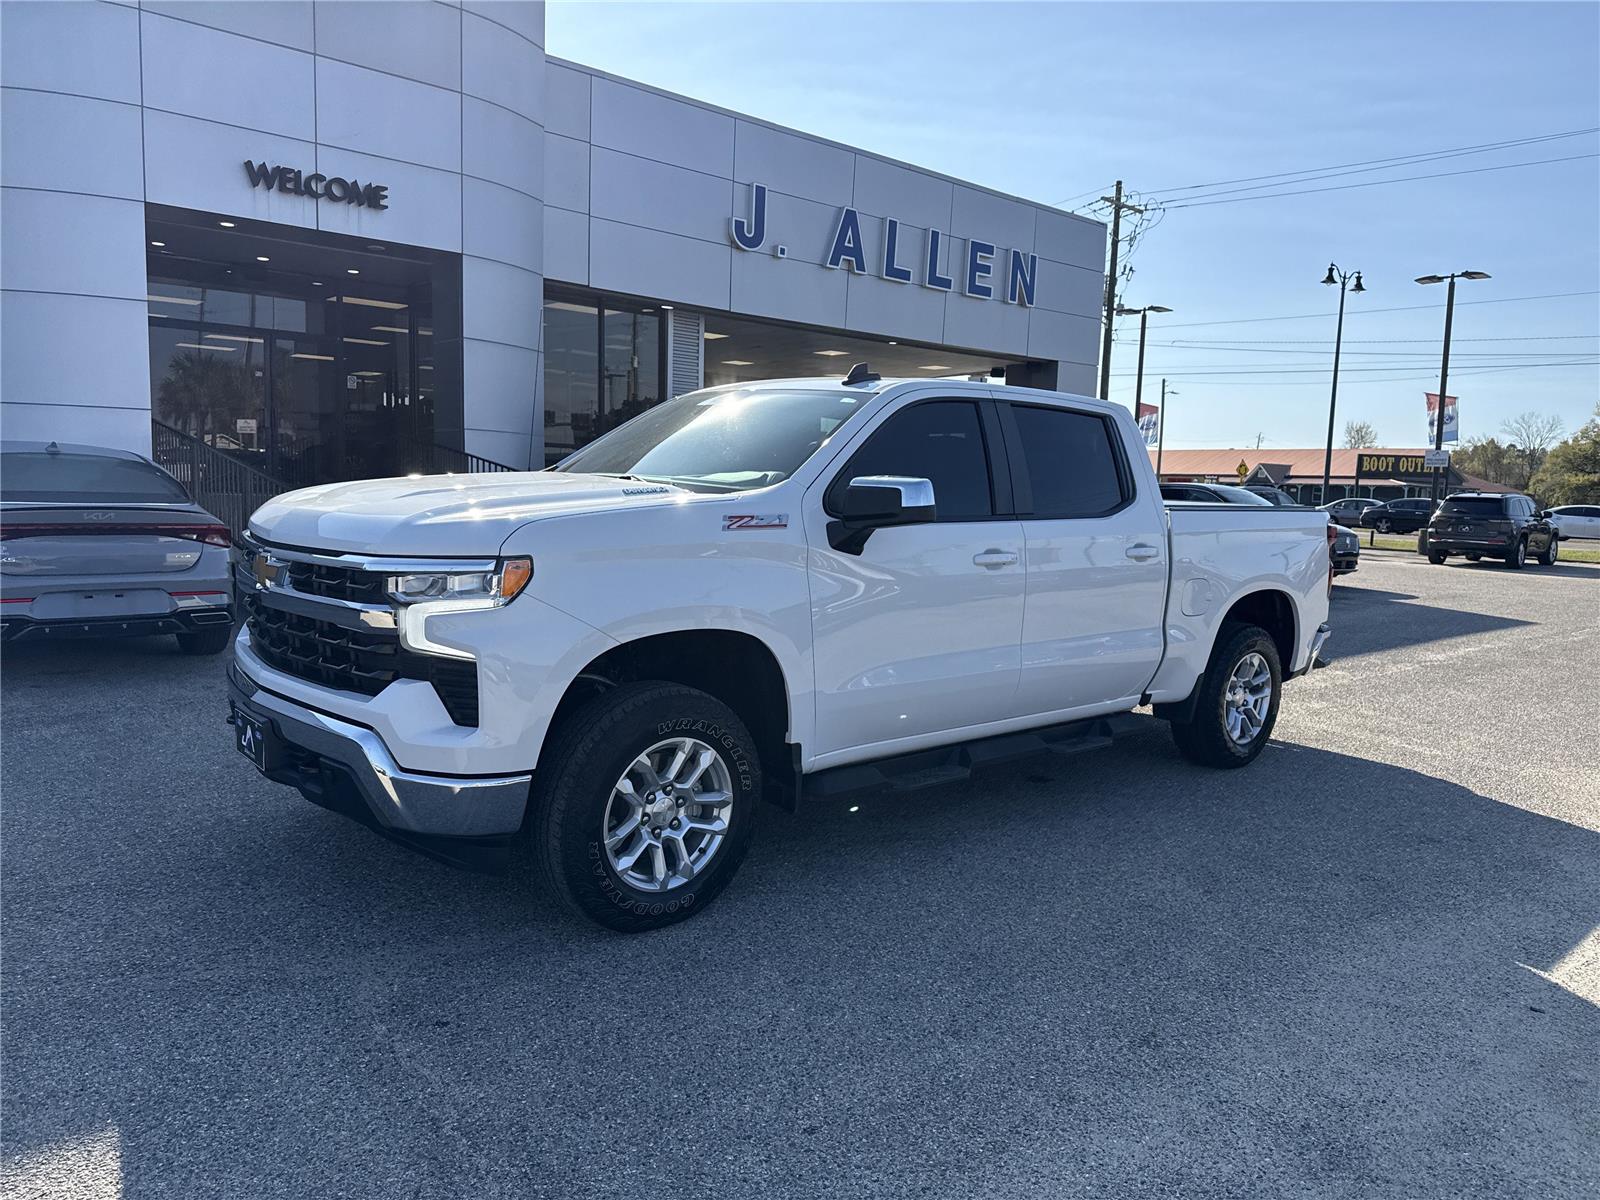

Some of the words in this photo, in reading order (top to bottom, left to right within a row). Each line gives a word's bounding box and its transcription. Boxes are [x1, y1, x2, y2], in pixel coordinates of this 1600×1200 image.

[243, 159, 389, 210] WELCOME
[729, 182, 788, 258] J.
[823, 206, 1038, 308] ALLEN
[1362, 456, 1395, 472] BOOT
[657, 717, 752, 791] WRANGLER
[589, 841, 695, 915] GOODYEAR
